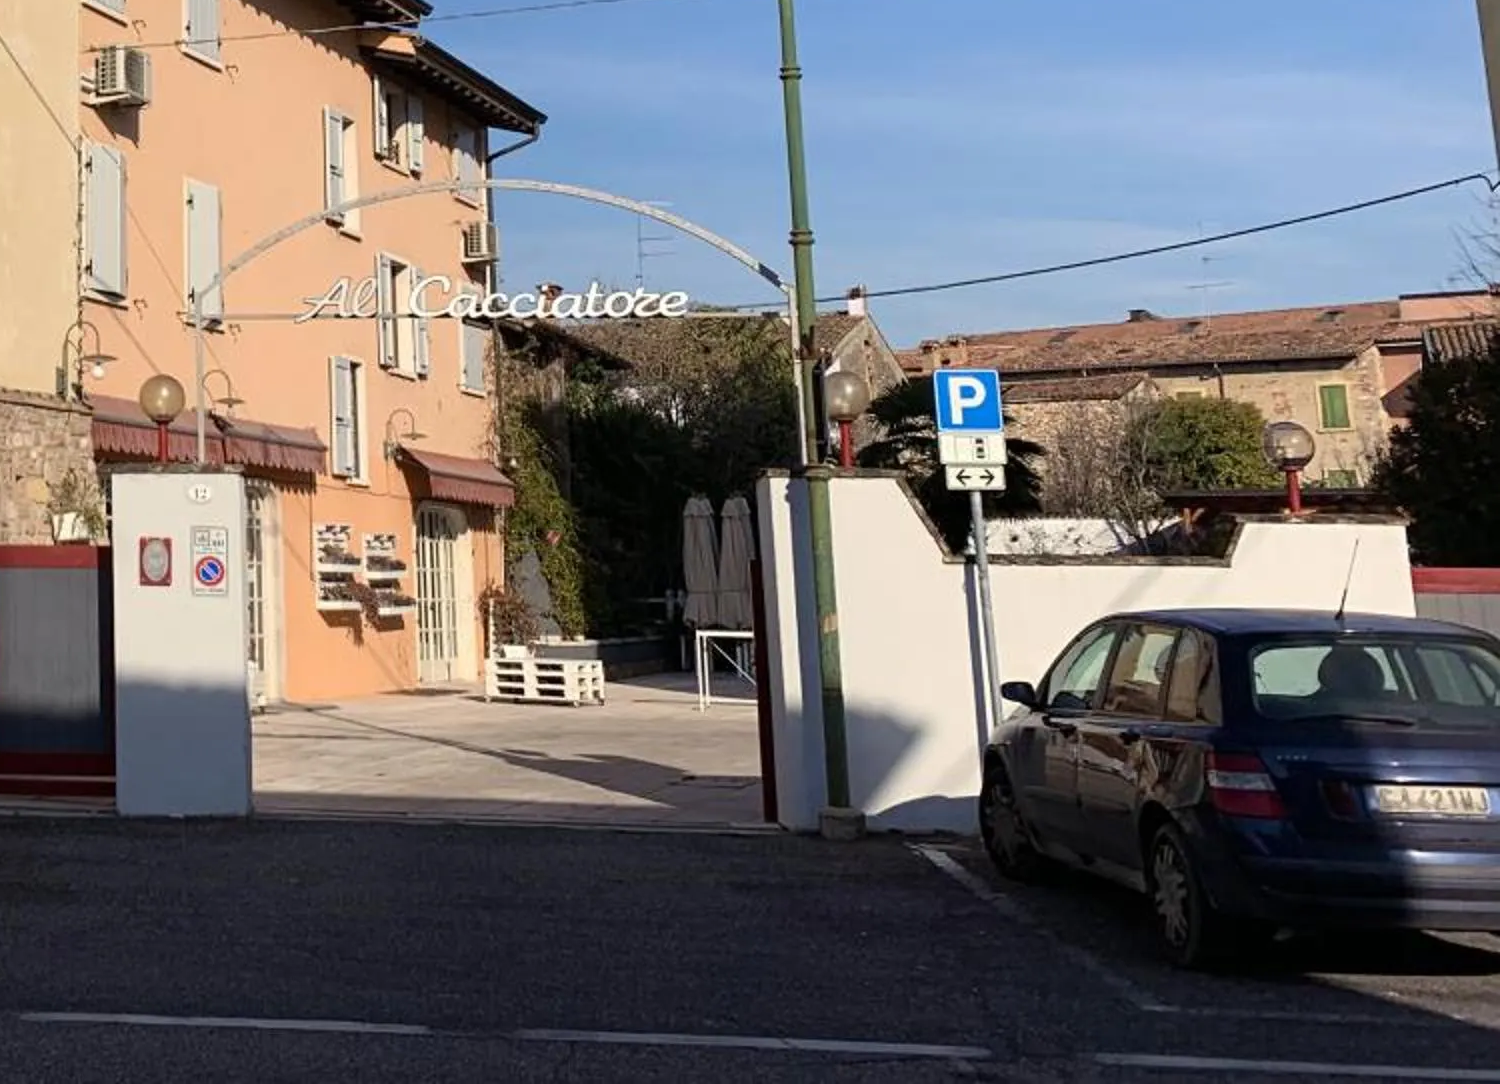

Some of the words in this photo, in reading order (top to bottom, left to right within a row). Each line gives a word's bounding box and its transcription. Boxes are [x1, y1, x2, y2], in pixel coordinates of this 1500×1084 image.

[299, 275, 379, 323] Al
[409, 275, 689, 319] Cacciatore
[947, 376, 987, 425] P
